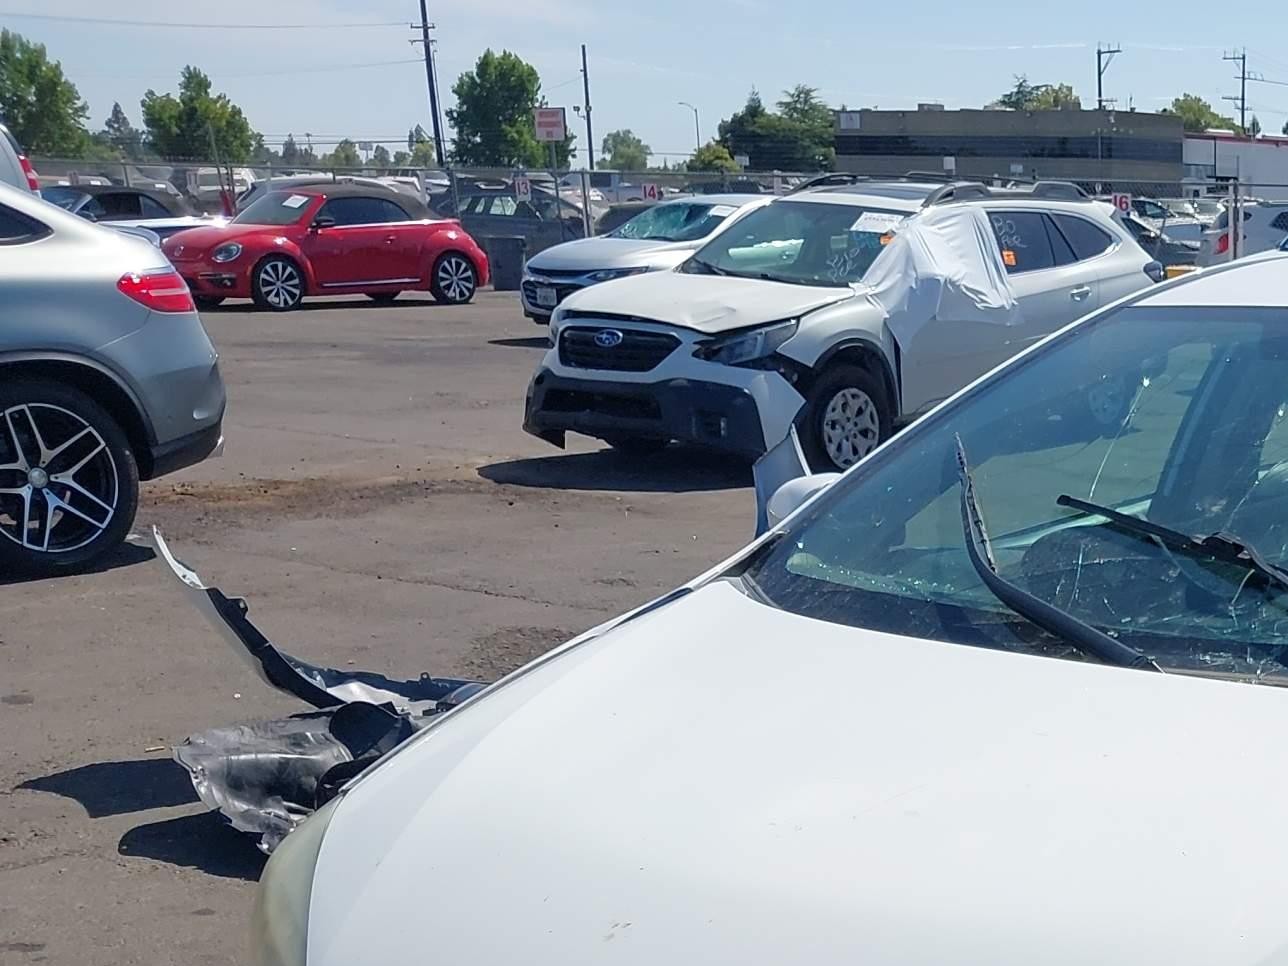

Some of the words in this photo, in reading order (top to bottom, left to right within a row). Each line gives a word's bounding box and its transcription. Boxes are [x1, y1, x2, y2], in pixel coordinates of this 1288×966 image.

[515, 181, 529, 196] 13
[643, 184, 657, 199] 14
[1113, 194, 1129, 211] 16
